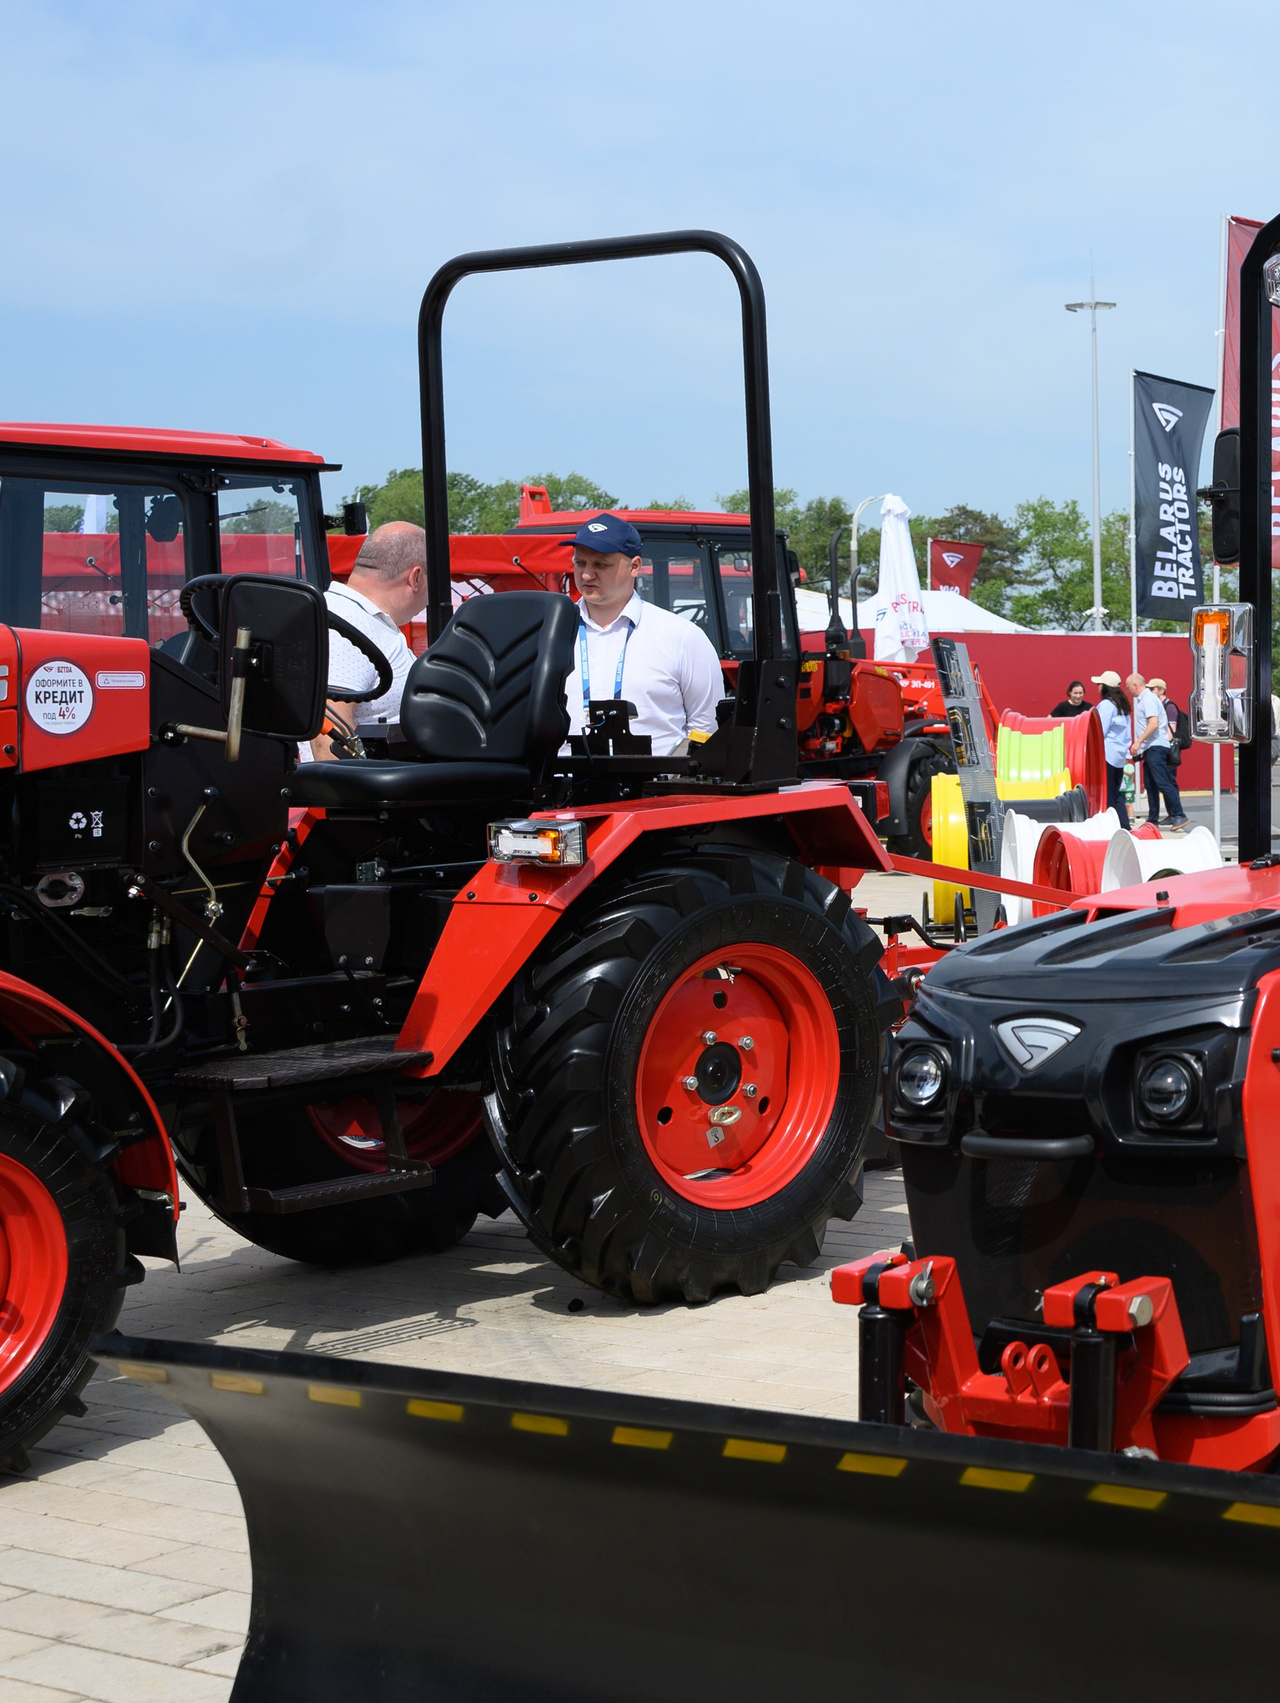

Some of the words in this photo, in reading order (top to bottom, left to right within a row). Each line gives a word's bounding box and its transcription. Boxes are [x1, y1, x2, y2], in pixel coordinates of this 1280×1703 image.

[1151, 462, 1180, 599] BELARUS
[1172, 466, 1197, 600] TRACTORS
[35, 679, 76, 688] ОФОРМИТЕ
[78, 679, 83, 688] В
[35, 690, 84, 705] КРЕДИТ
[58, 706, 76, 720] 4%
